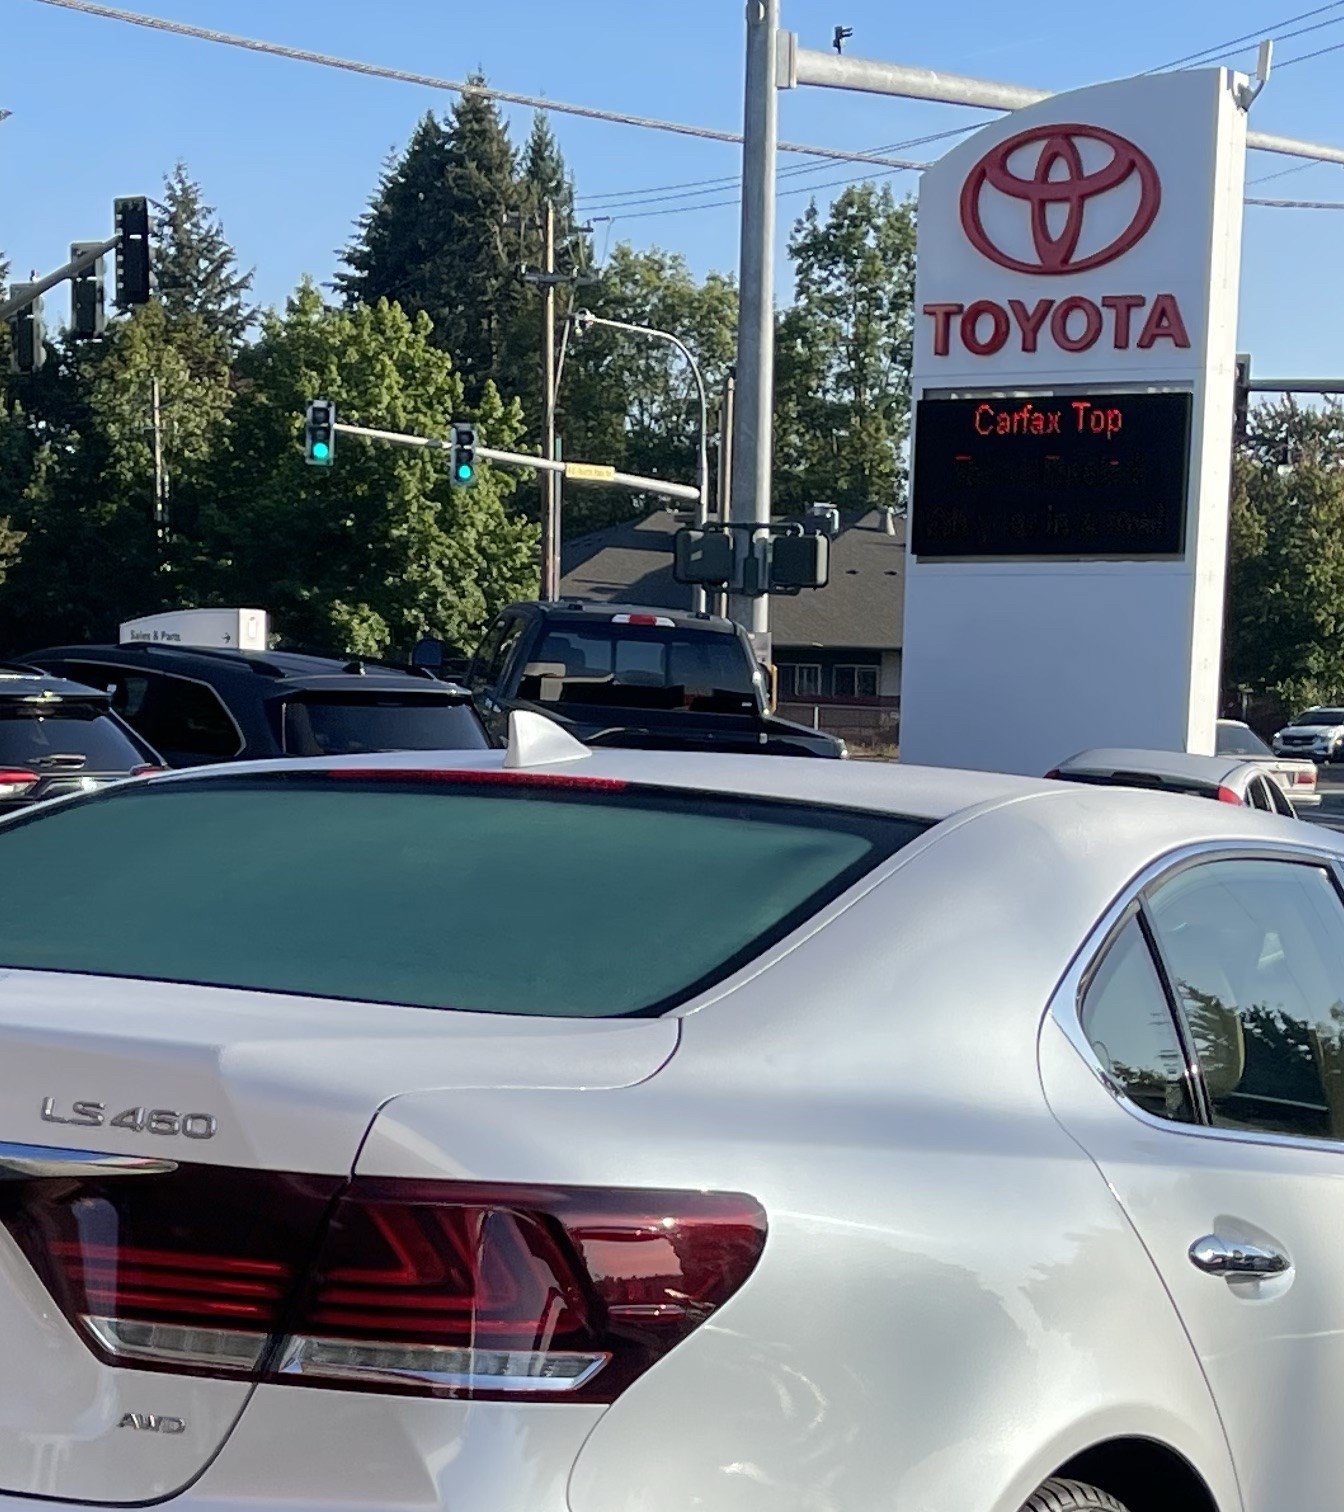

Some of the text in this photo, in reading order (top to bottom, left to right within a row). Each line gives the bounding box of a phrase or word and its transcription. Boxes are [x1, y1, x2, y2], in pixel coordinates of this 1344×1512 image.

[923, 294, 1191, 356] TOYOTA
[974, 401, 1123, 440] Carfax Top
[130, 630, 150, 640] Sales
[161, 631, 181, 641] Parts
[41, 1097, 218, 1139] LS 460
[116, 1412, 186, 1433] AWD
